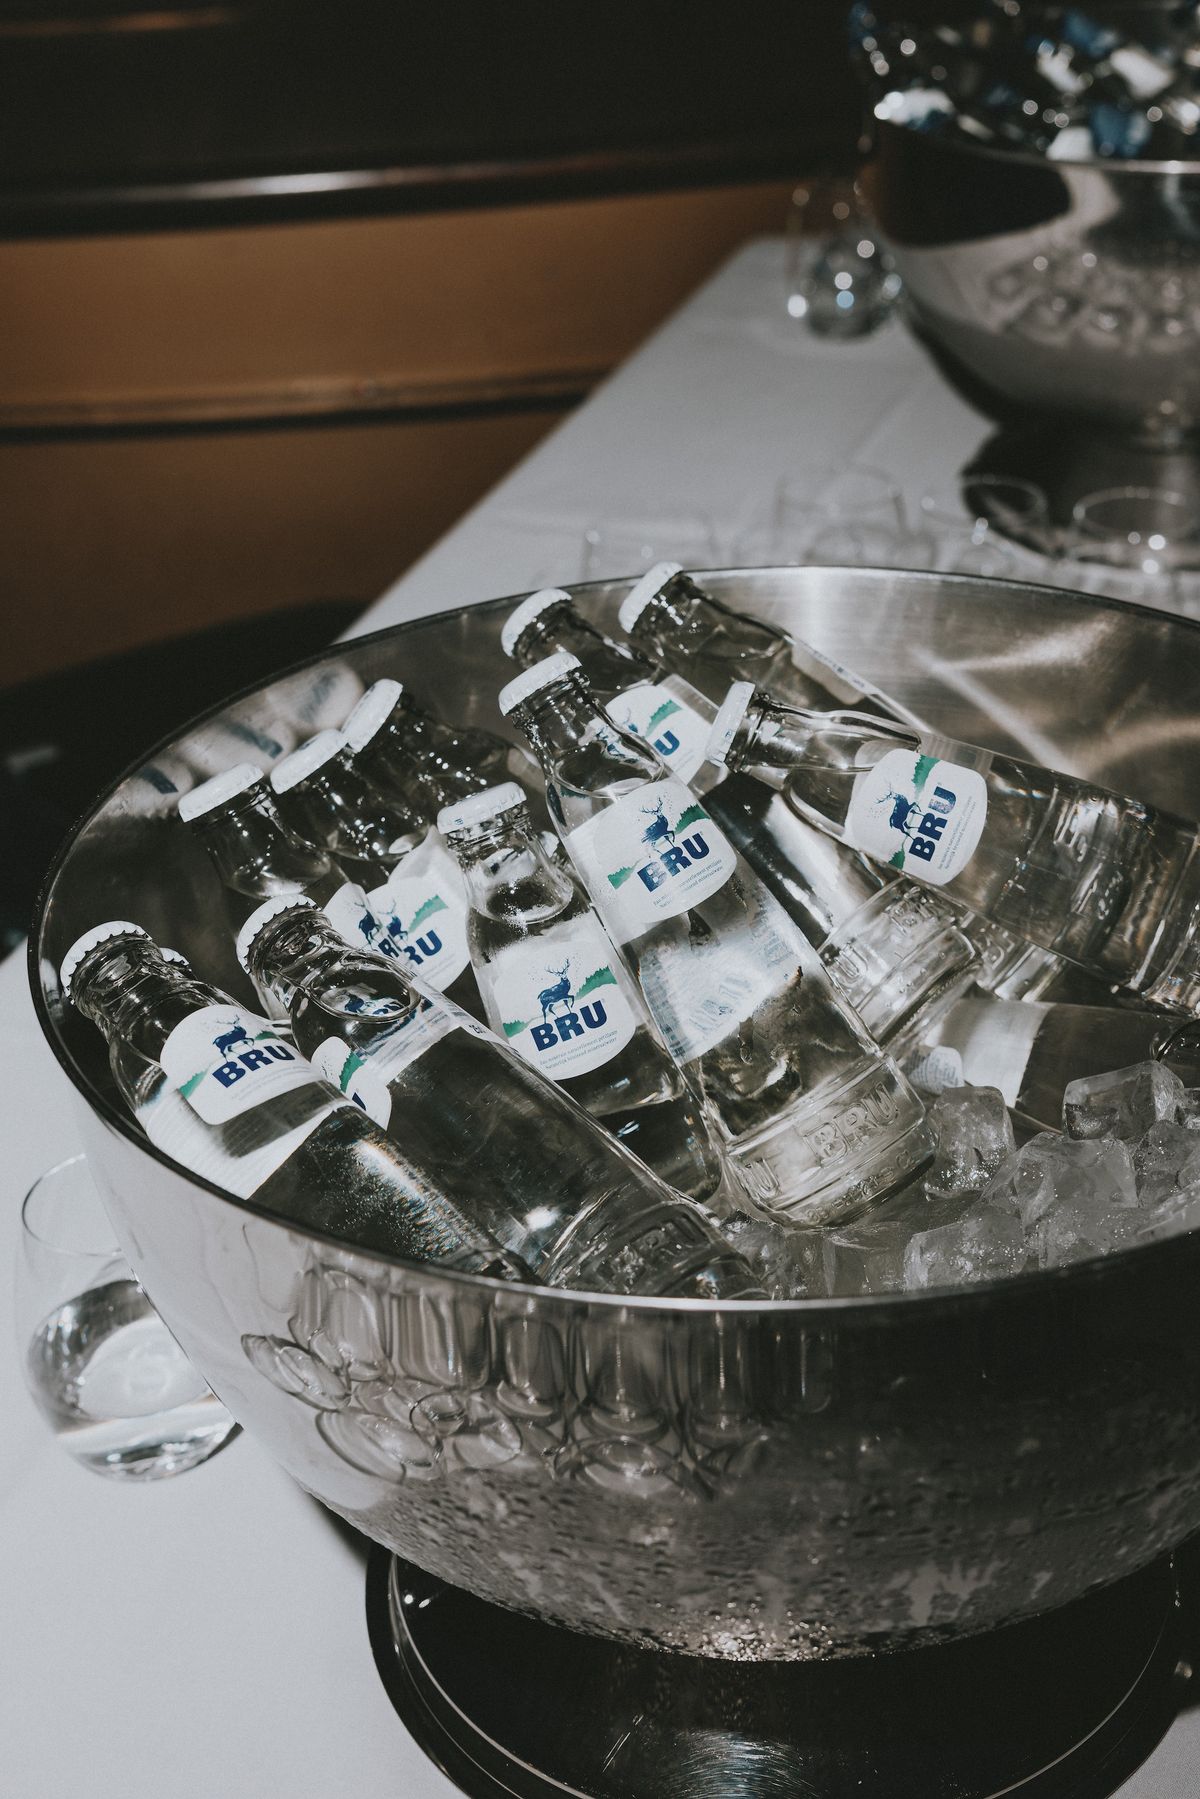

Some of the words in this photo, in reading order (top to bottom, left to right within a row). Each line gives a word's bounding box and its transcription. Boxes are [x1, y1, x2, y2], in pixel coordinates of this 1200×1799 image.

[908, 786, 956, 862] BRU
[637, 833, 709, 892] BRU
[403, 930, 442, 965] RU
[530, 1000, 607, 1051] BRU
[212, 1045, 295, 1088] BRU
[803, 1081, 899, 1168] BRU
